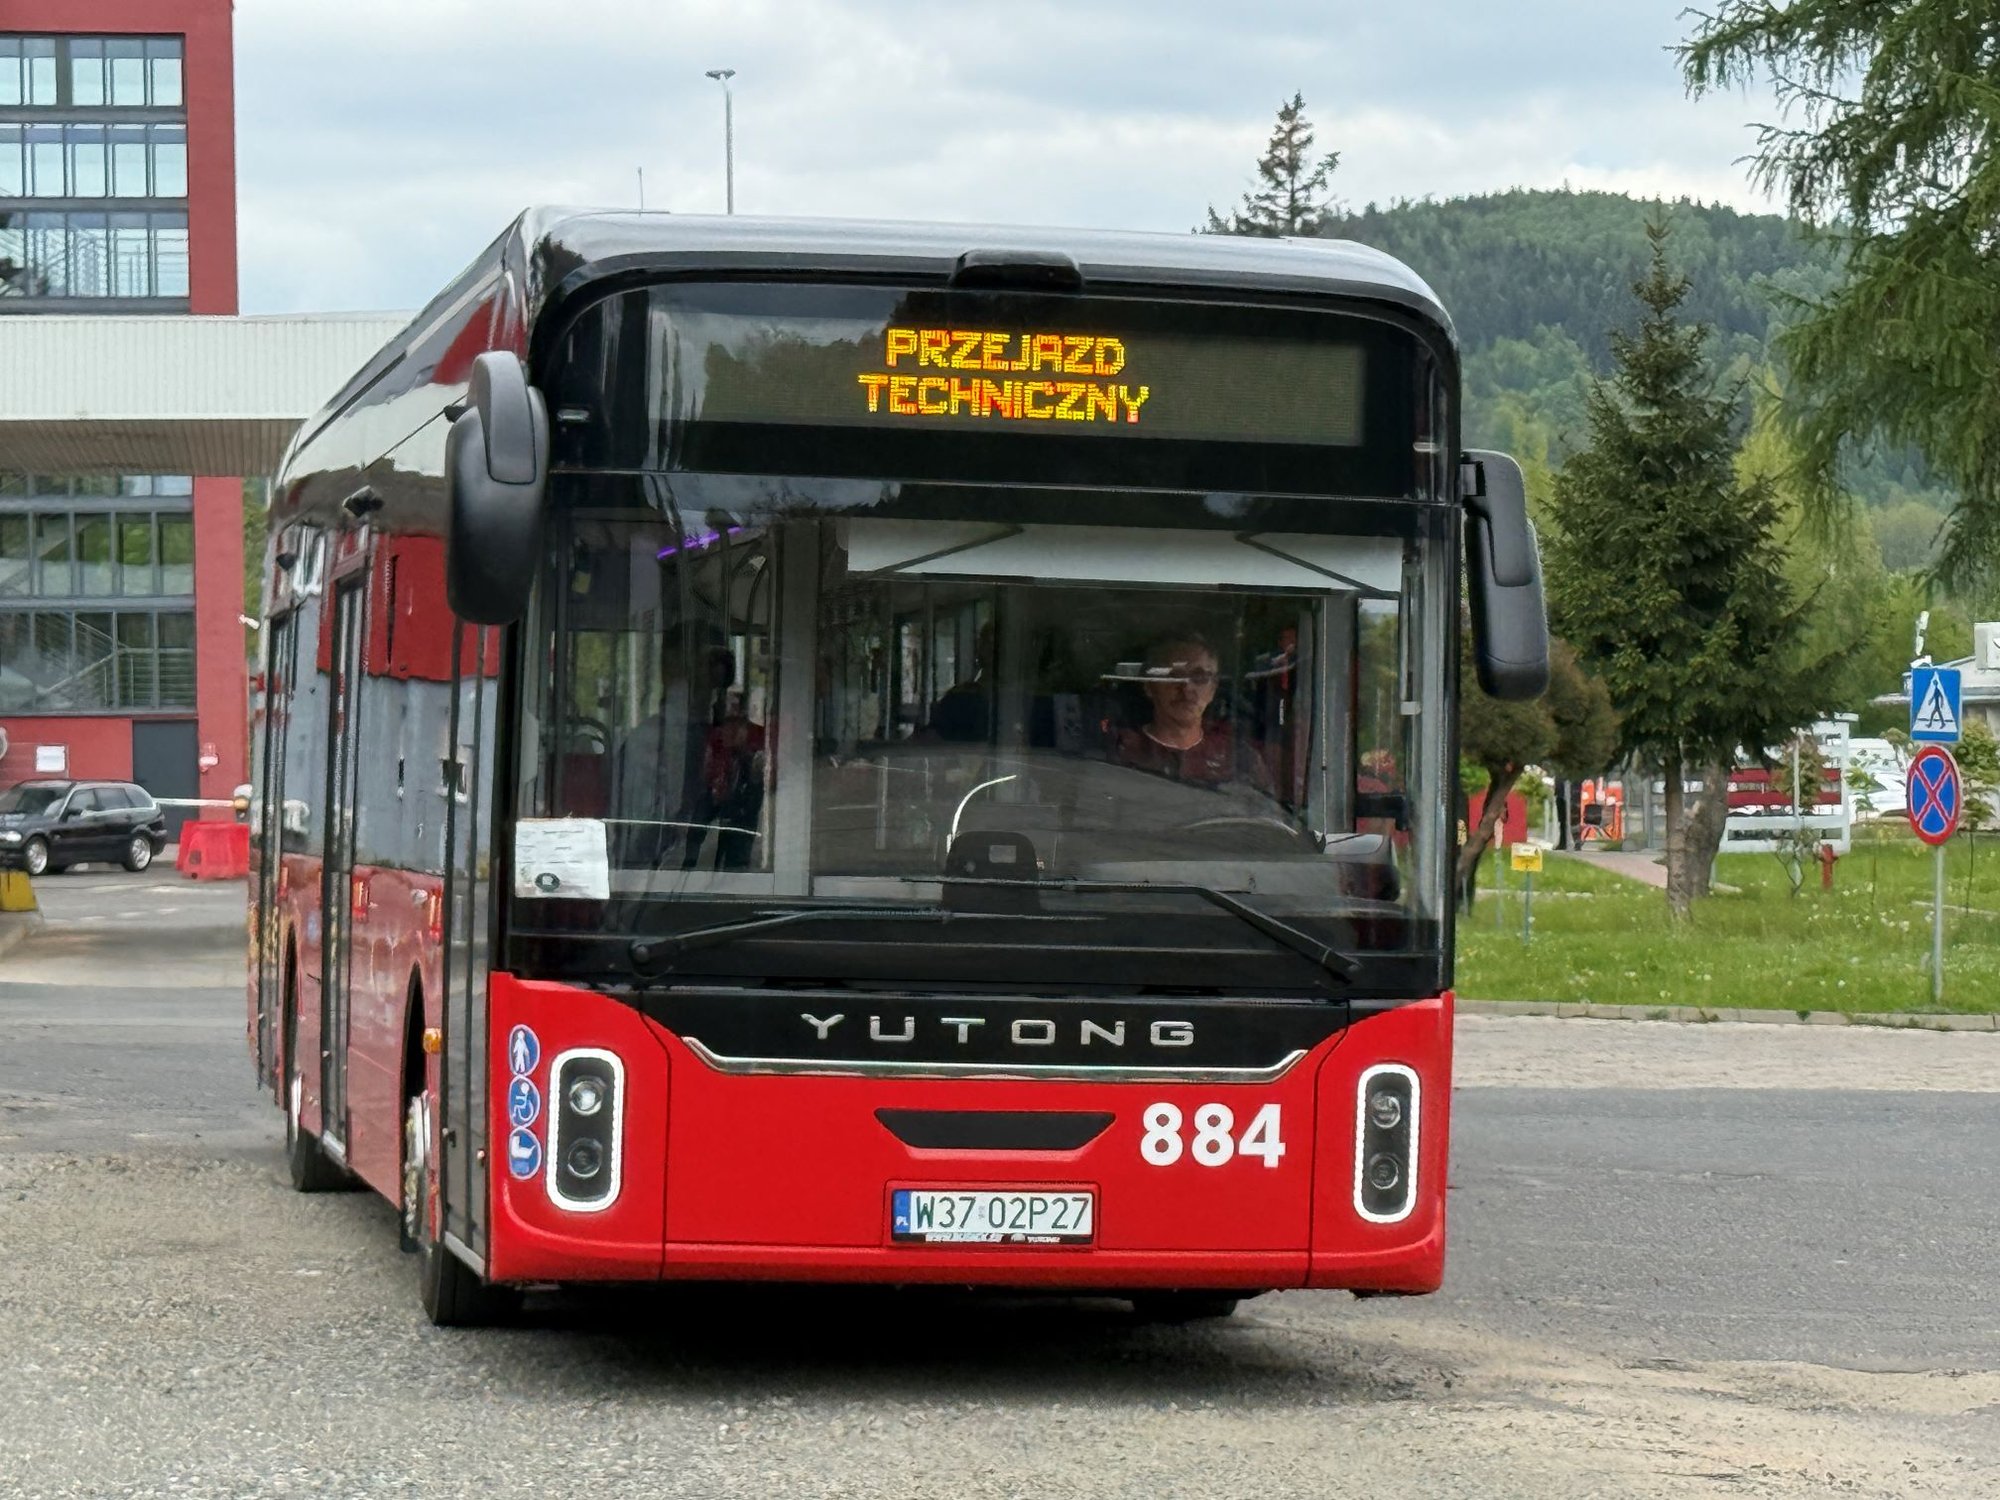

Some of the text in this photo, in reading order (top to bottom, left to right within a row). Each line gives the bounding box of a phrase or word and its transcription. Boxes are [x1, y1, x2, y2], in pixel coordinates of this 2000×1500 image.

[886, 328, 1125, 375] PRZEJAZD
[858, 373, 1149, 423] TECHNICZNY
[801, 1013, 1195, 1046] YUTONG
[1141, 1102, 1286, 1168] 884
